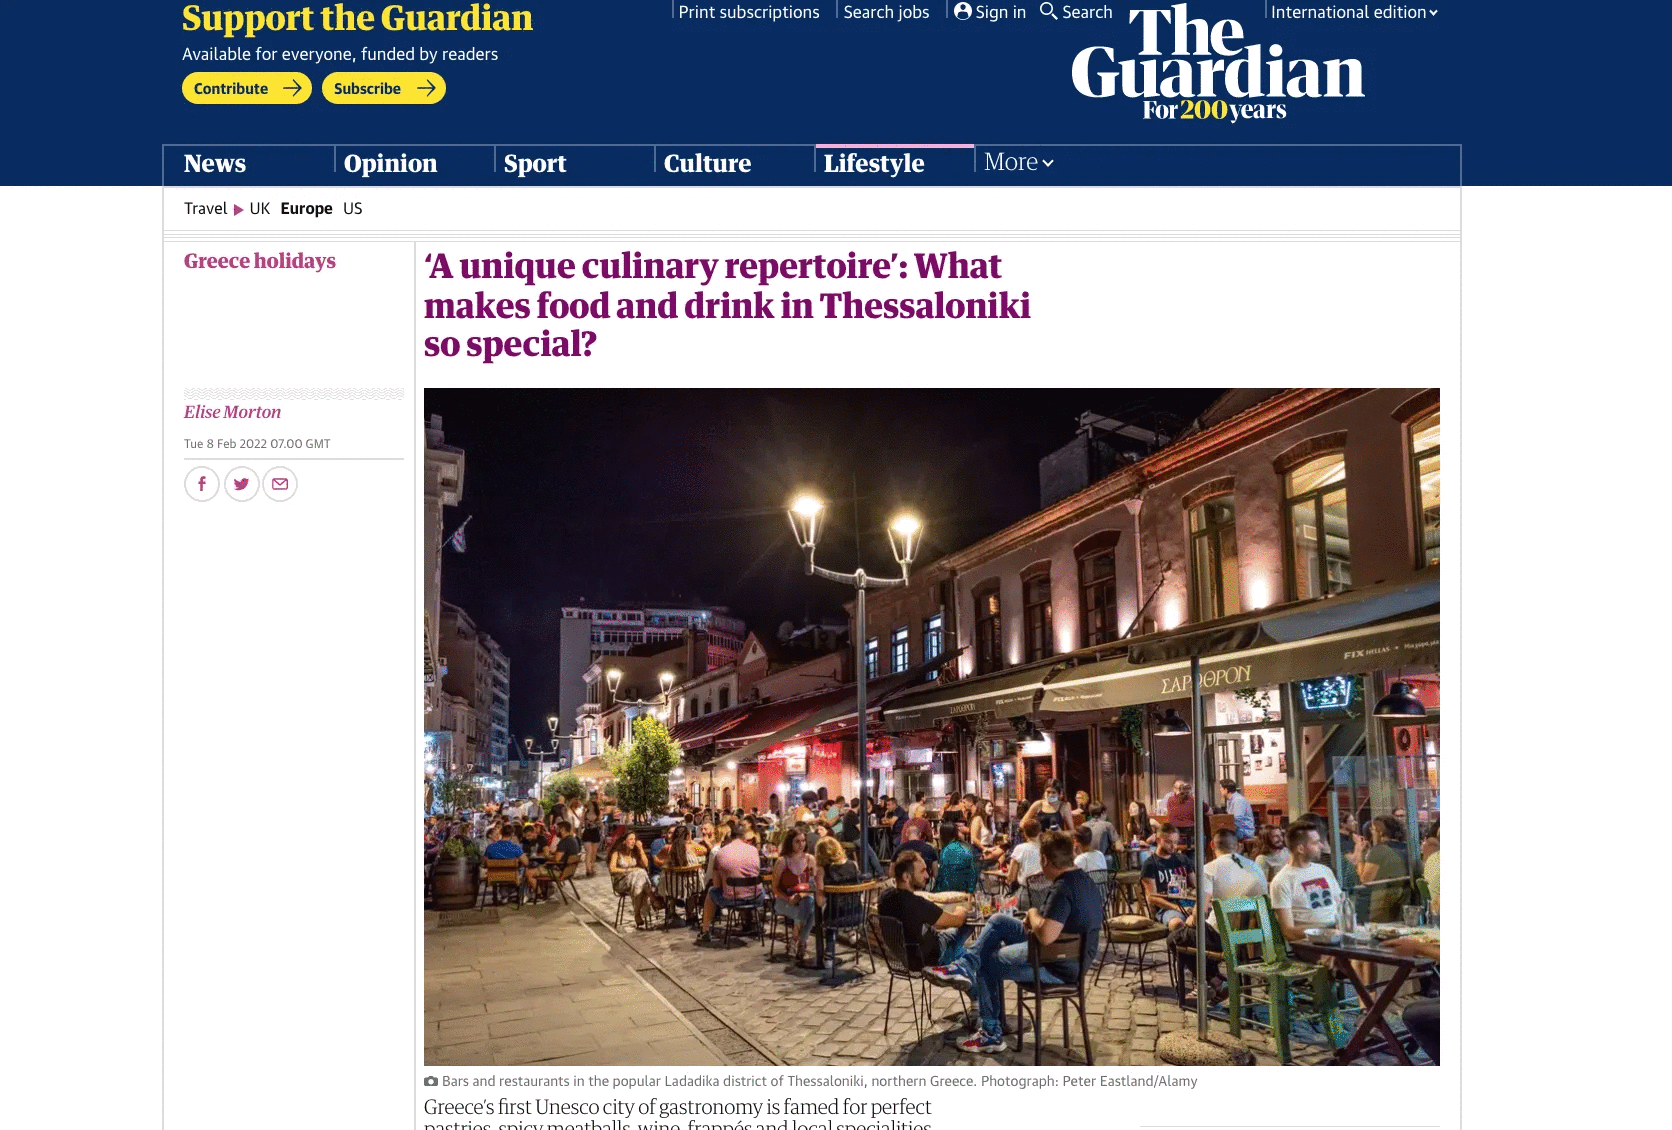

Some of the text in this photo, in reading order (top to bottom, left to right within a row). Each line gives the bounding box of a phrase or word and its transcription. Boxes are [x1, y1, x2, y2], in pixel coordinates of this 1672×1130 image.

[183, 3, 533, 38] Support the Guardian
[679, 5, 820, 23] Print subscriptions
[844, 5, 930, 23] Search jobs
[976, 5, 1027, 23] Sign in
[1063, 5, 1113, 19] Search
[1271, 5, 1427, 19] International edition
[1129, 3, 1244, 56] The
[182, 46, 499, 65] Available for everyone, funded by readers
[1071, 44, 1365, 98] Guardian
[193, 81, 269, 96] Contribute
[334, 81, 402, 96] Subscribe
[1143, 100, 1287, 124] For 200 years
[184, 153, 247, 174] News
[344, 152, 439, 178] Opinion
[504, 153, 568, 178] Sport
[664, 152, 752, 174] Culture
[824, 152, 925, 179] Lifestyle
[984, 151, 1038, 172] More
[183, 201, 229, 215] Travel
[250, 202, 271, 215] UK
[280, 202, 334, 219] Europe
[343, 202, 363, 216] US
[184, 252, 337, 274] Greece holidays
[459, 251, 575, 287] unique
[582, 251, 719, 287] culinary
[914, 251, 1003, 280] What
[424, 290, 1032, 320] makes food and drink in Thessaloniki
[424, 328, 598, 365] so special?
[184, 404, 282, 420] Elise Morton
[184, 438, 331, 449] Tue 8 Feb 2022 07.00 GMT
[1344, 648, 1364, 660] FIX
[443, 1075, 1198, 1090] Bars and restaurants in the popular Ladadika district of Thessaloniki, northern Greece. Photograph: Peter Eastland/Alamy
[498, 1098, 533, 1116] first
[535, 1099, 600, 1116] Unesco
[603, 1099, 636, 1119] city
[638, 1098, 657, 1116] of
[659, 1099, 763, 1119] gastronomy
[767, 1099, 781, 1116] is
[784, 1098, 840, 1115] famed
[843, 1098, 868, 1116] for
[871, 1098, 933, 1119] perfect
